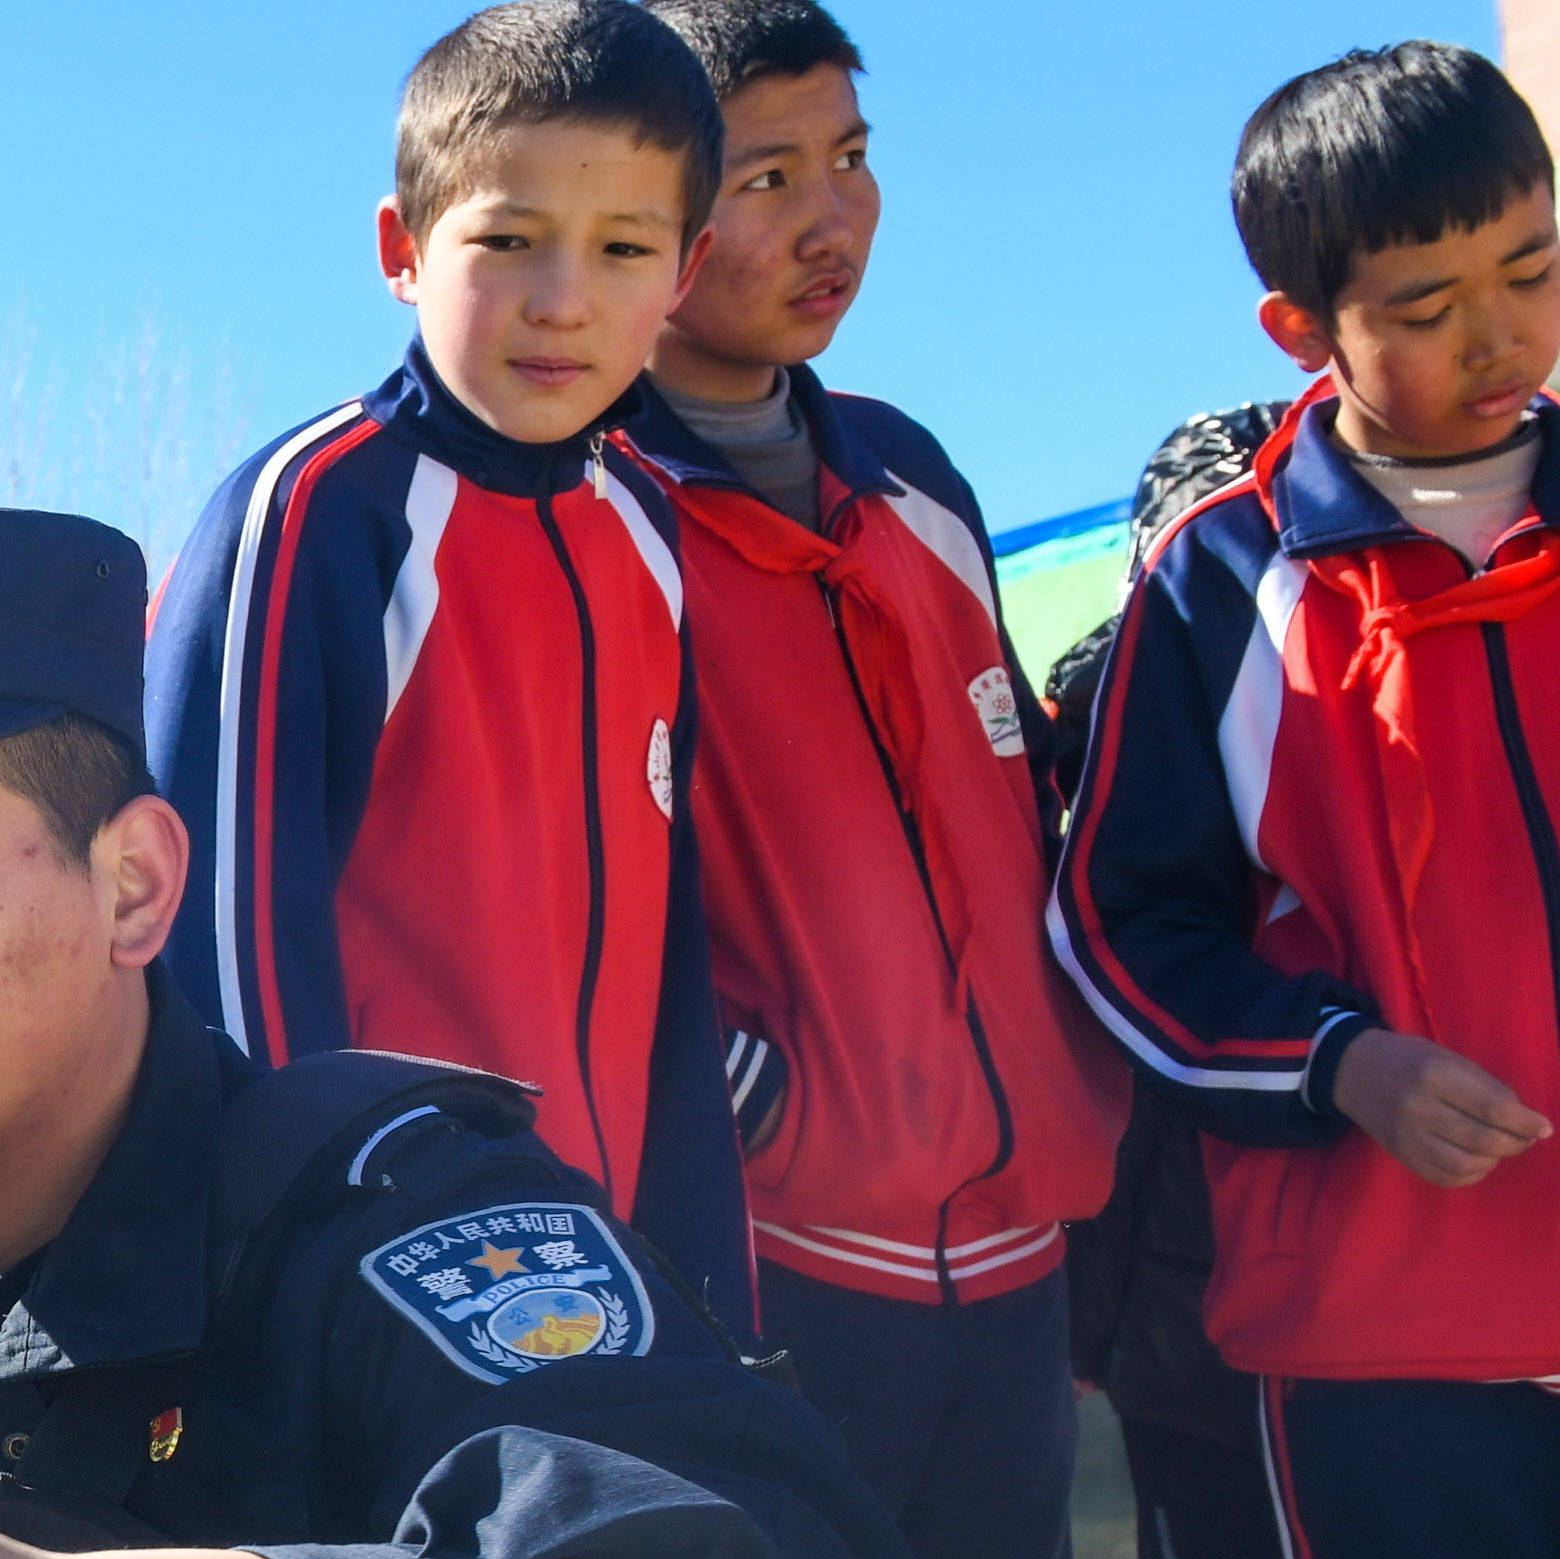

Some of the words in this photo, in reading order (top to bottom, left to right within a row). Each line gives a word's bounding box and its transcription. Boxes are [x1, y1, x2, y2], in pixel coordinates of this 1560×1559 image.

[386, 1213, 576, 1277] 中华人民共和国
[483, 1273, 566, 1303] POLICE
